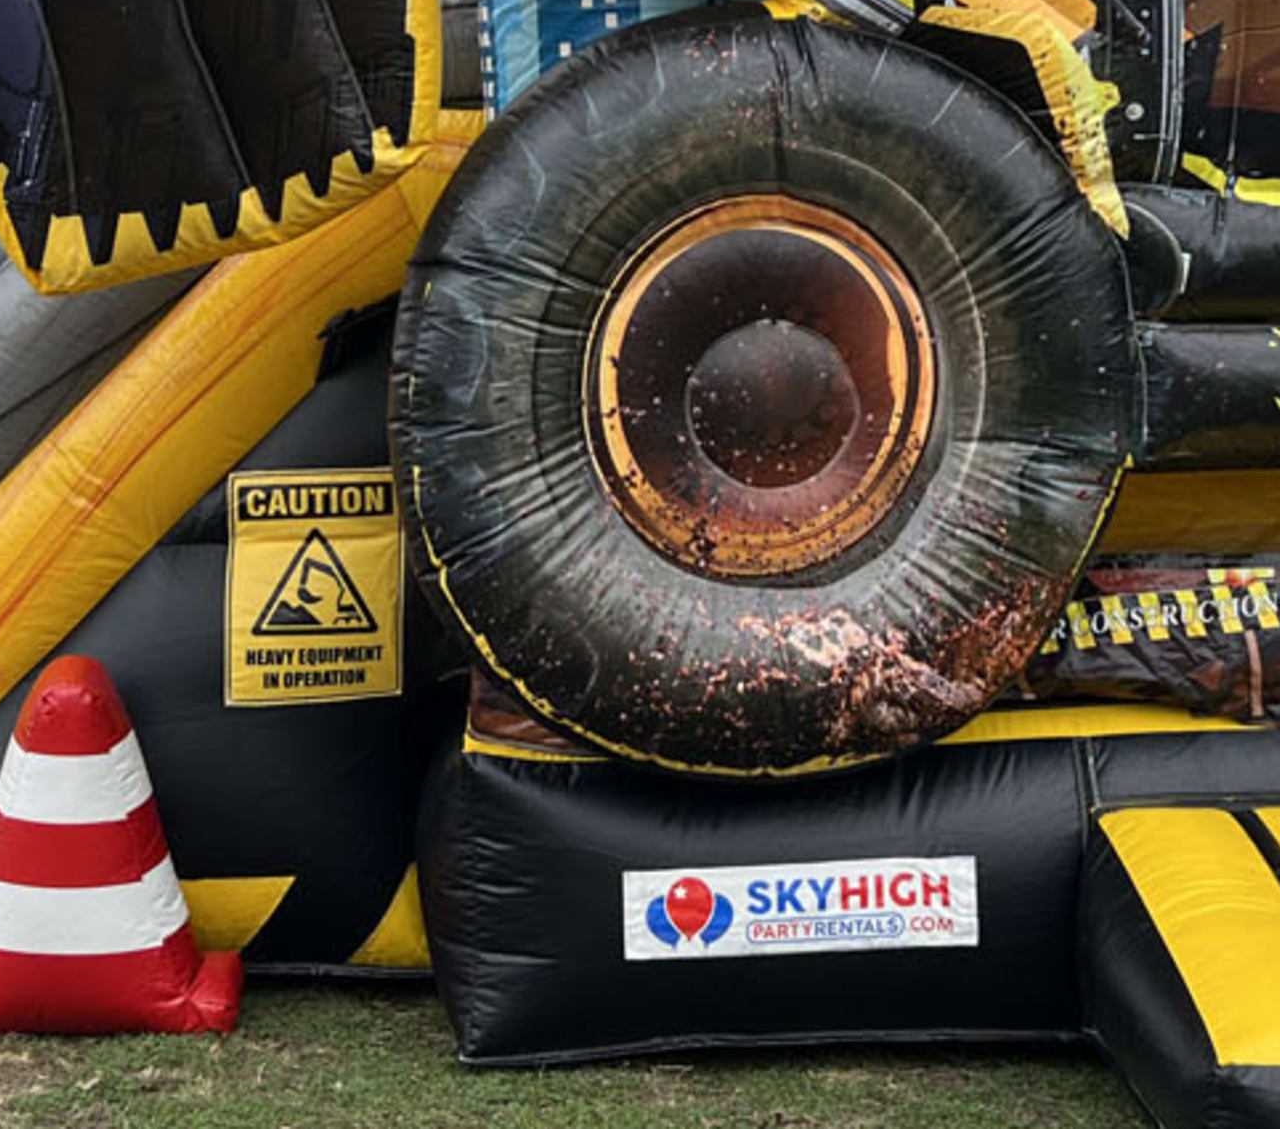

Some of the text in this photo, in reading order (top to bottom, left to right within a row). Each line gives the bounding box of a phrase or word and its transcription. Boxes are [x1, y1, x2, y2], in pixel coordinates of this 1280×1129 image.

[245, 484, 387, 517] CAUTION
[245, 644, 383, 667] HEAVY EQUIPMENT
[262, 668, 366, 689] IN OPERATION
[746, 871, 951, 915] SKYHIGH
